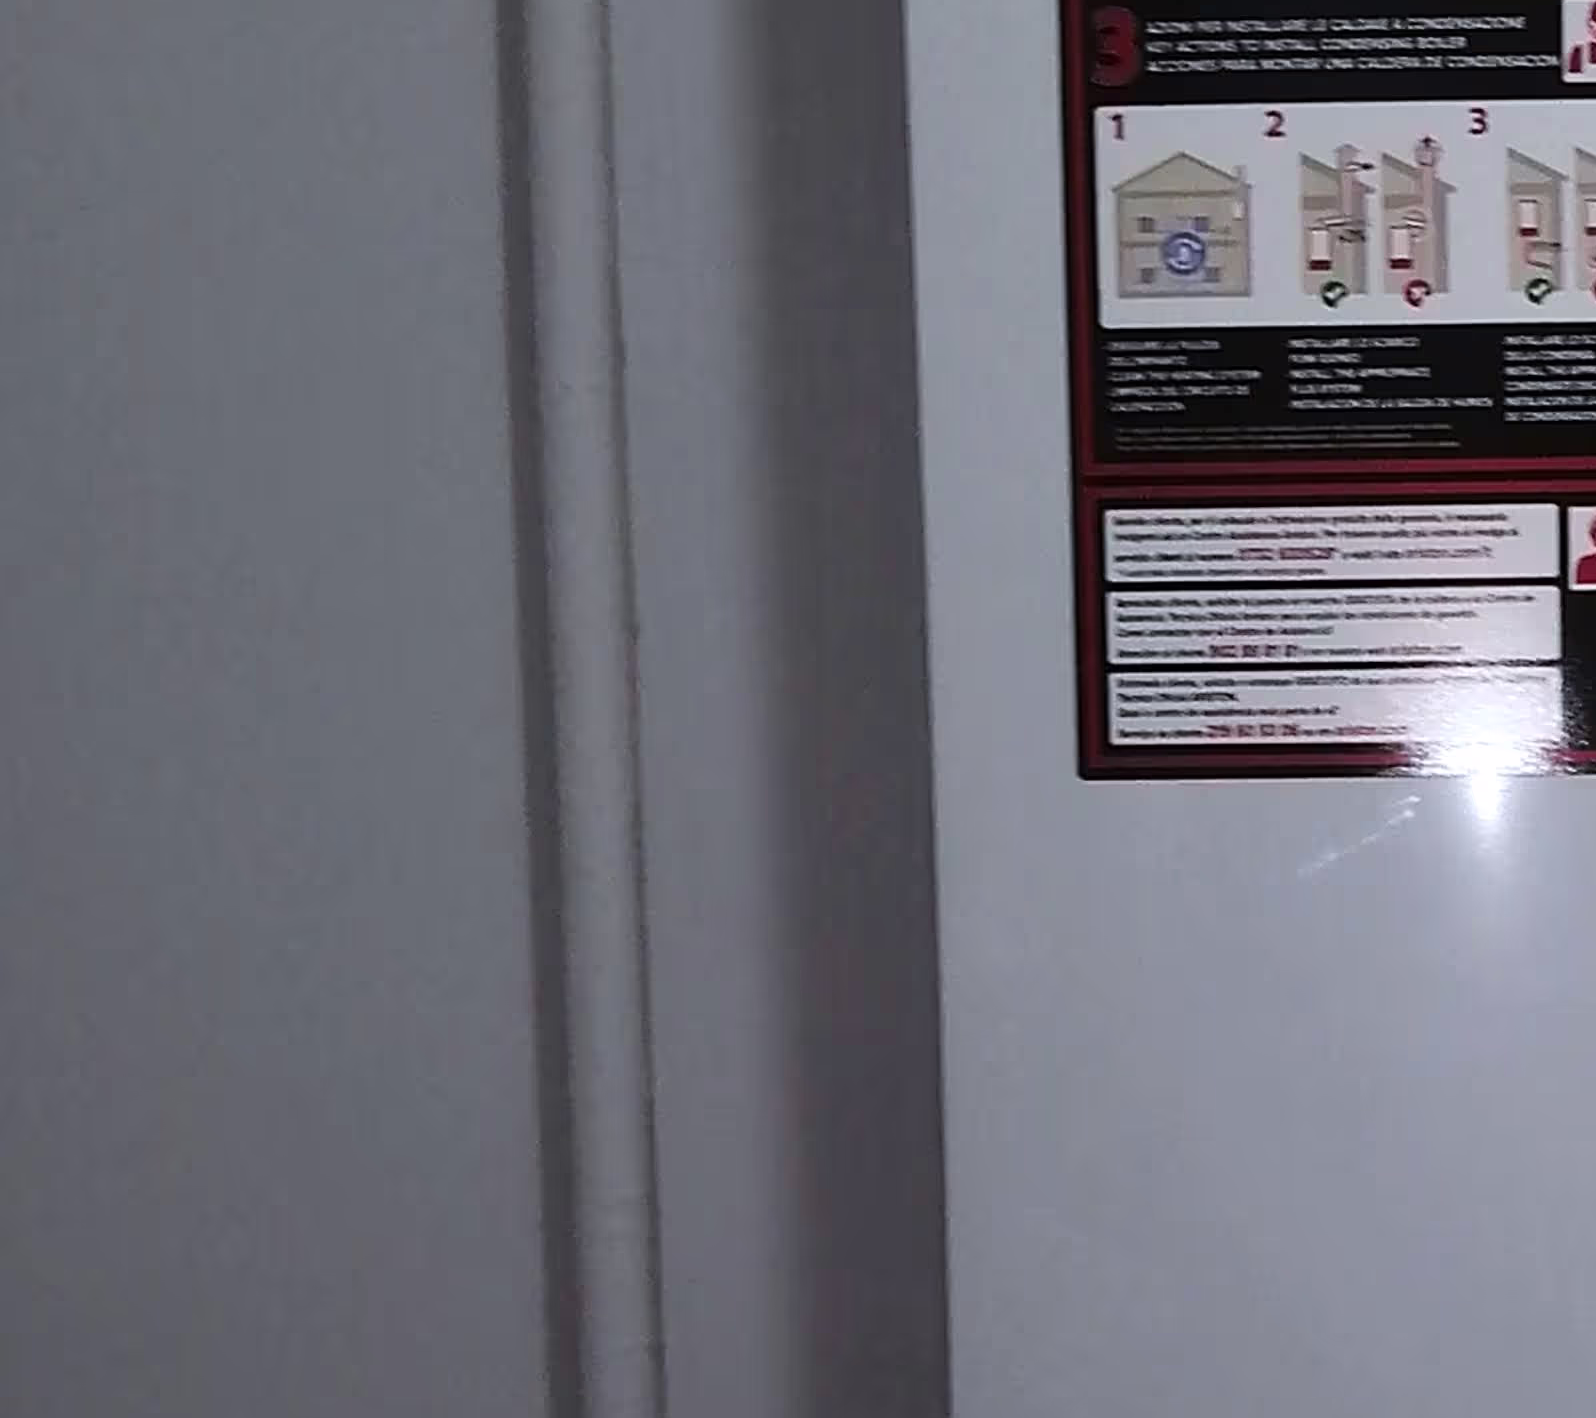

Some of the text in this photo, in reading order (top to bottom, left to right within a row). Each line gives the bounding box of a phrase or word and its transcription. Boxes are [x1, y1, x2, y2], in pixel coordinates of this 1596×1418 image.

[1111, 113, 1126, 141] 1
[1262, 110, 1286, 138] 2
[1467, 107, 1489, 135] 3
